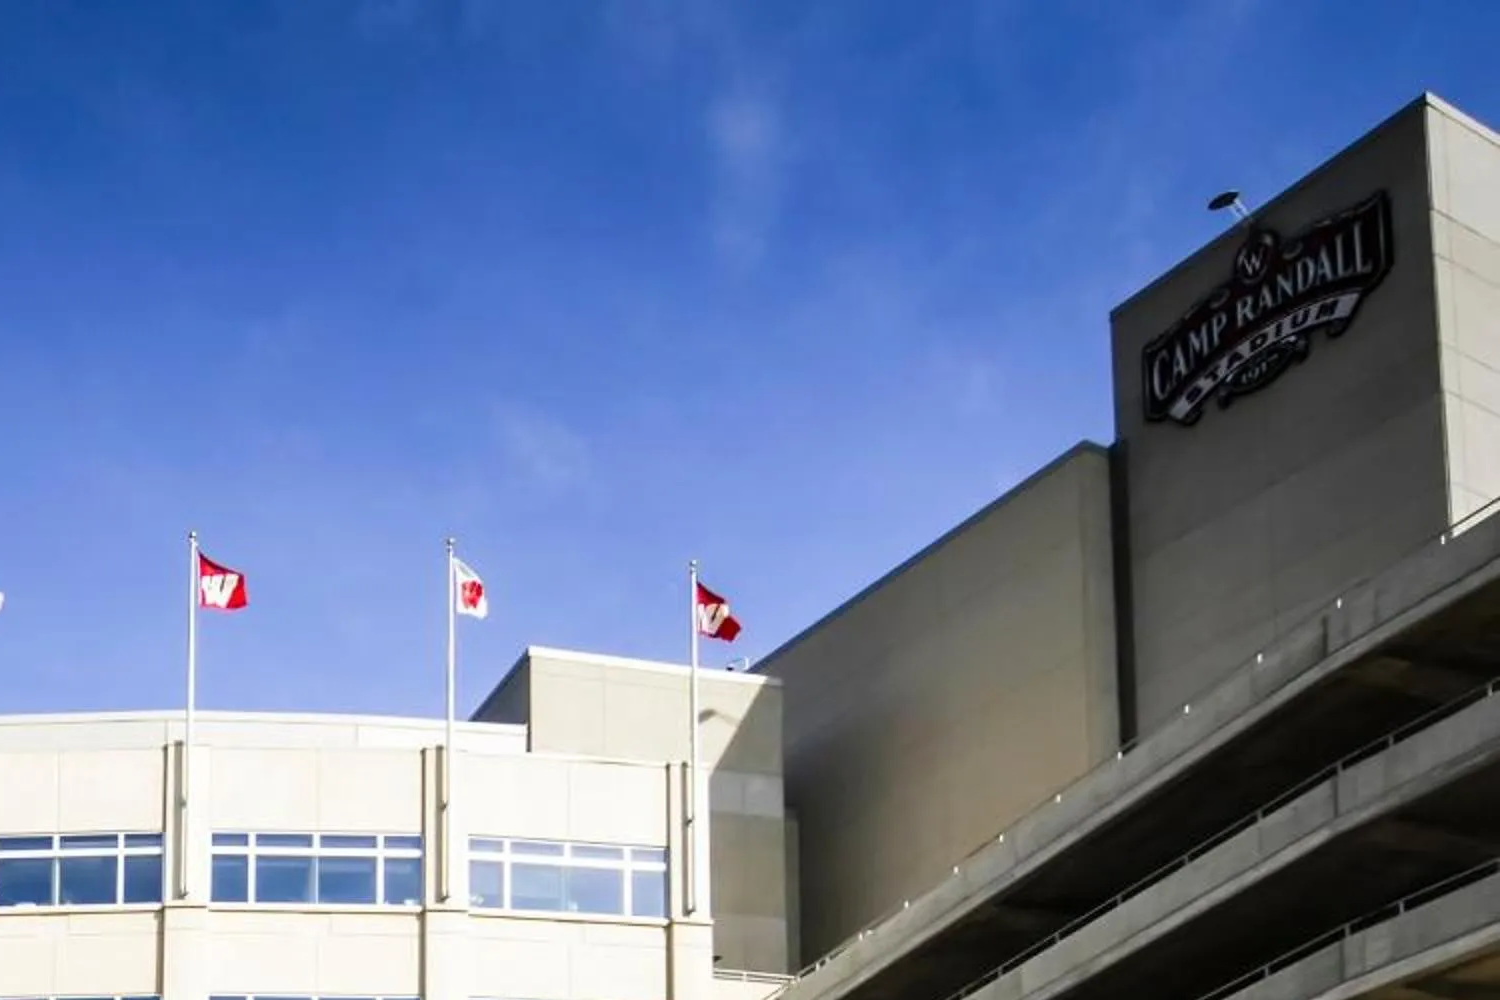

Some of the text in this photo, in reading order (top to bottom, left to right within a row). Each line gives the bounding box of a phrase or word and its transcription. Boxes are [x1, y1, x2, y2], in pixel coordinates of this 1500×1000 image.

[1152, 220, 1373, 400] CAMP RANDALL
[1237, 244, 1265, 277] W
[1184, 299, 1340, 402] STADIUM
